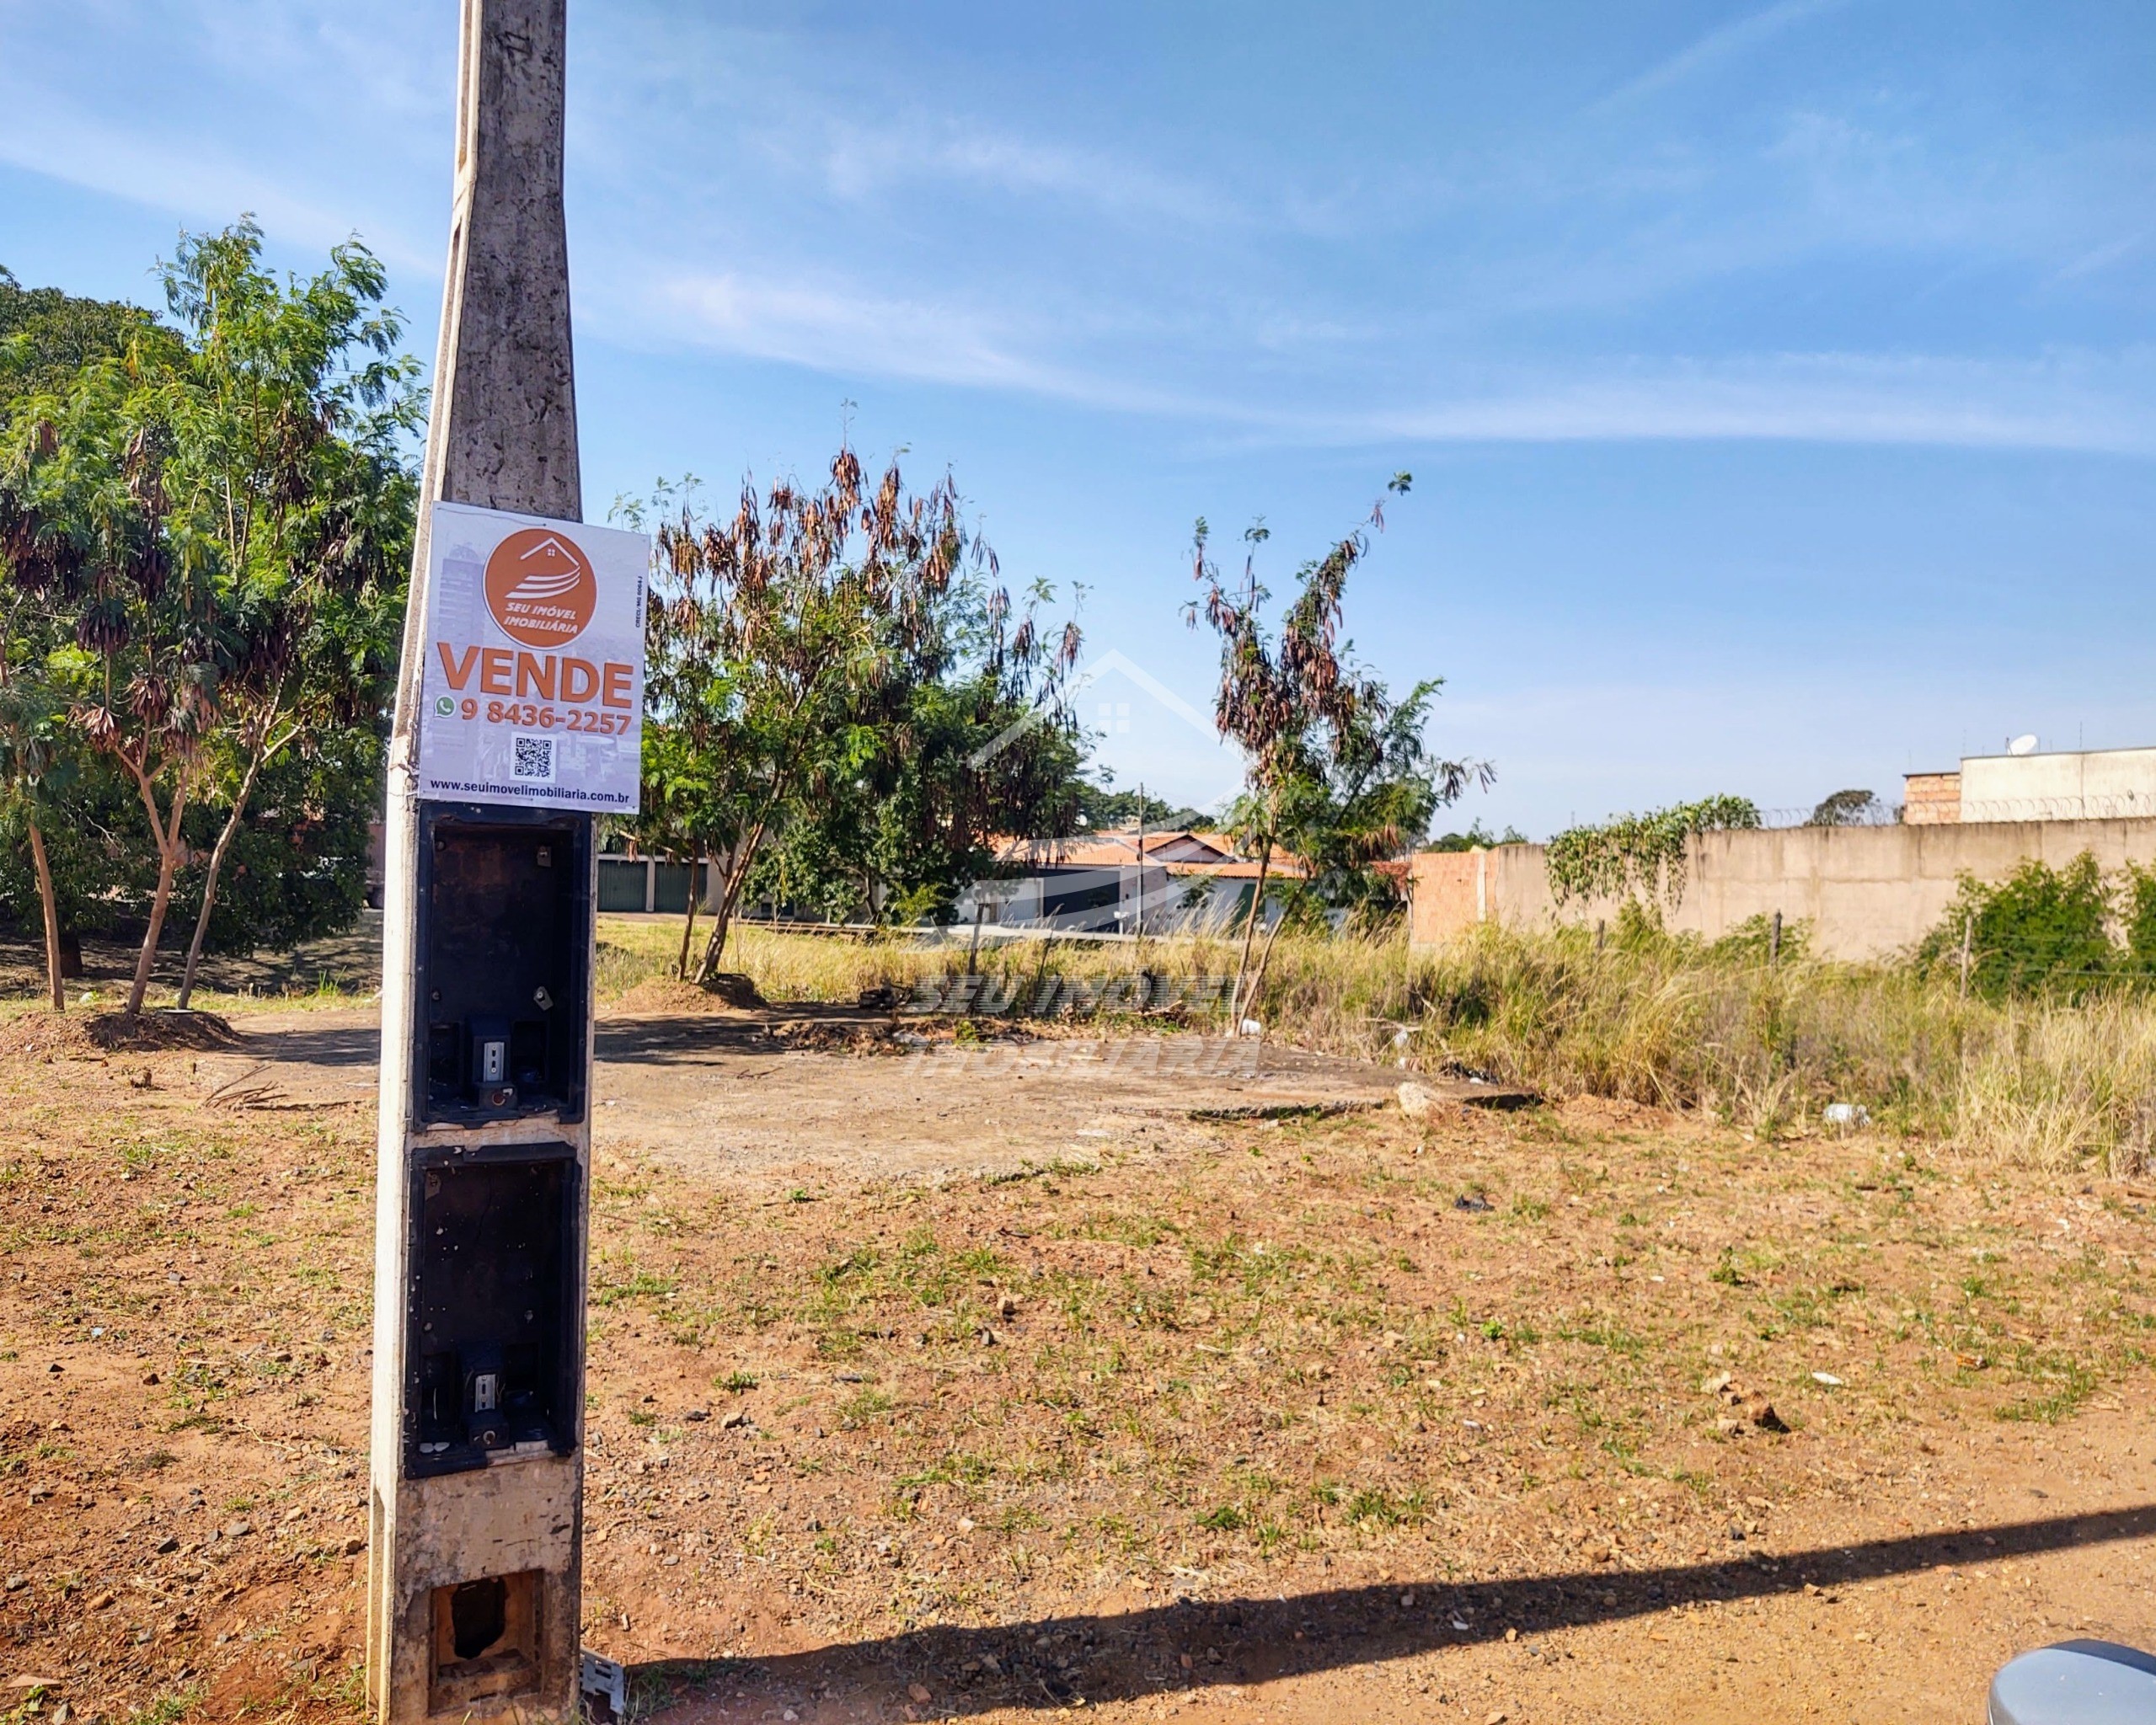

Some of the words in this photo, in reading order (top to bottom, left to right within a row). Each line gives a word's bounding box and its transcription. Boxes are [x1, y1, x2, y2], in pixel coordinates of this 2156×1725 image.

[506, 602, 531, 614] SEU
[532, 605, 576, 620] IMÓVEL
[504, 616, 579, 634] IMOBILIÁRIA
[436, 642, 634, 709] VENDE
[461, 698, 479, 721] 9
[487, 701, 632, 735] 8436-2257
[430, 778, 630, 804] www.seuimovelimobiliaria.com.br
